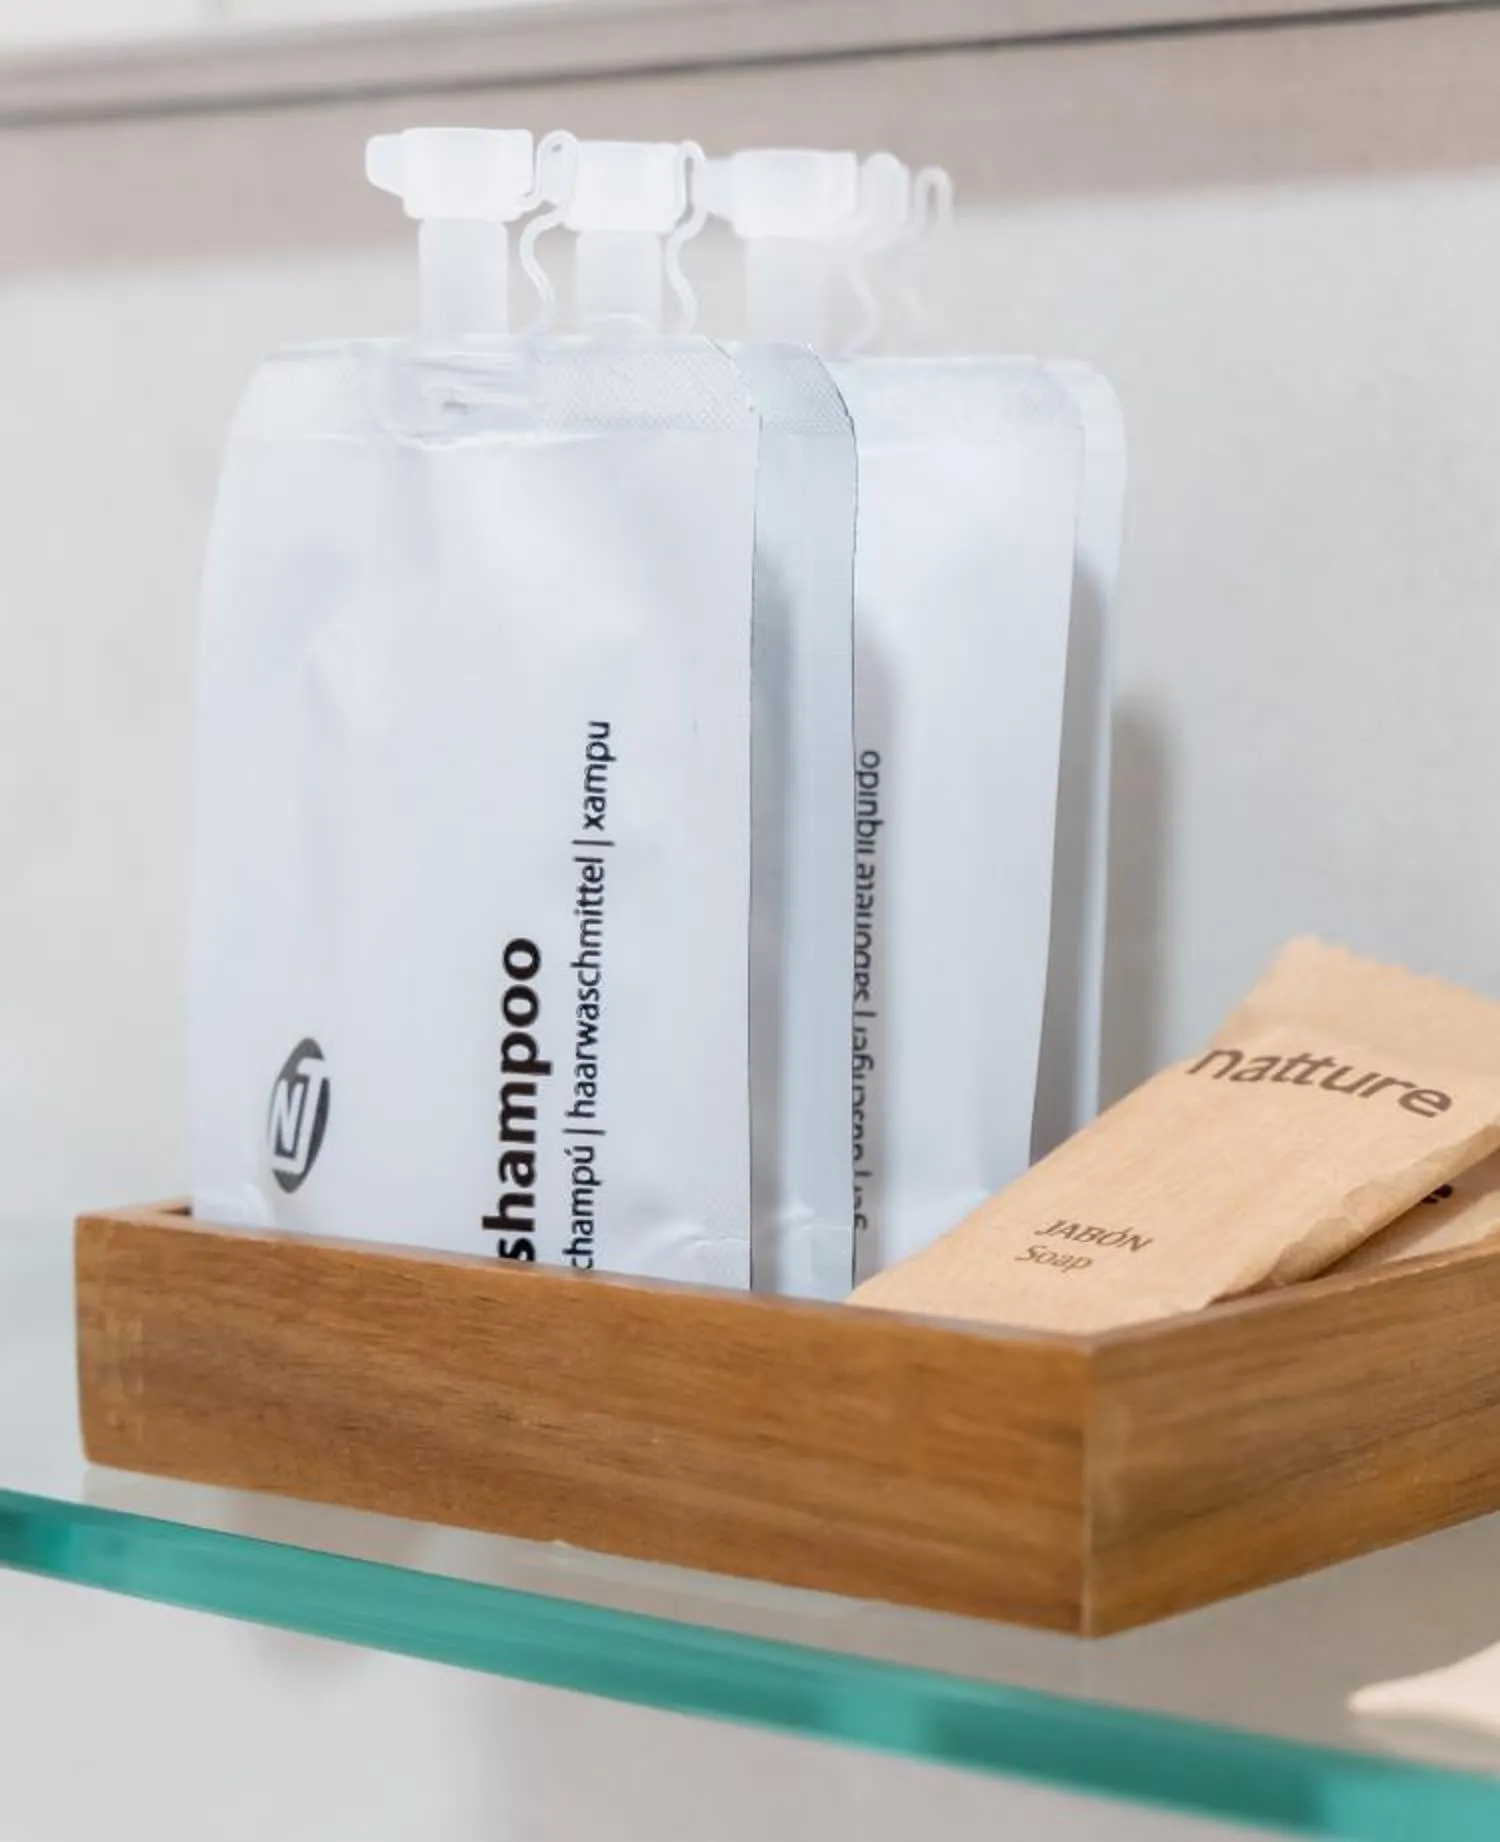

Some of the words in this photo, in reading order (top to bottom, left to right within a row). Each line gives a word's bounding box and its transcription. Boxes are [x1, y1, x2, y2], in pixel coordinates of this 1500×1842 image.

[582, 720, 617, 832] xampu
[564, 856, 605, 1119] haarwaschmittel
[481, 937, 552, 1263] shampoo
[1185, 1048, 1453, 1119] natture
[562, 1145, 604, 1271] champú
[1014, 1244, 1094, 1274] Soap
[1033, 1219, 1155, 1252] JABÓN
